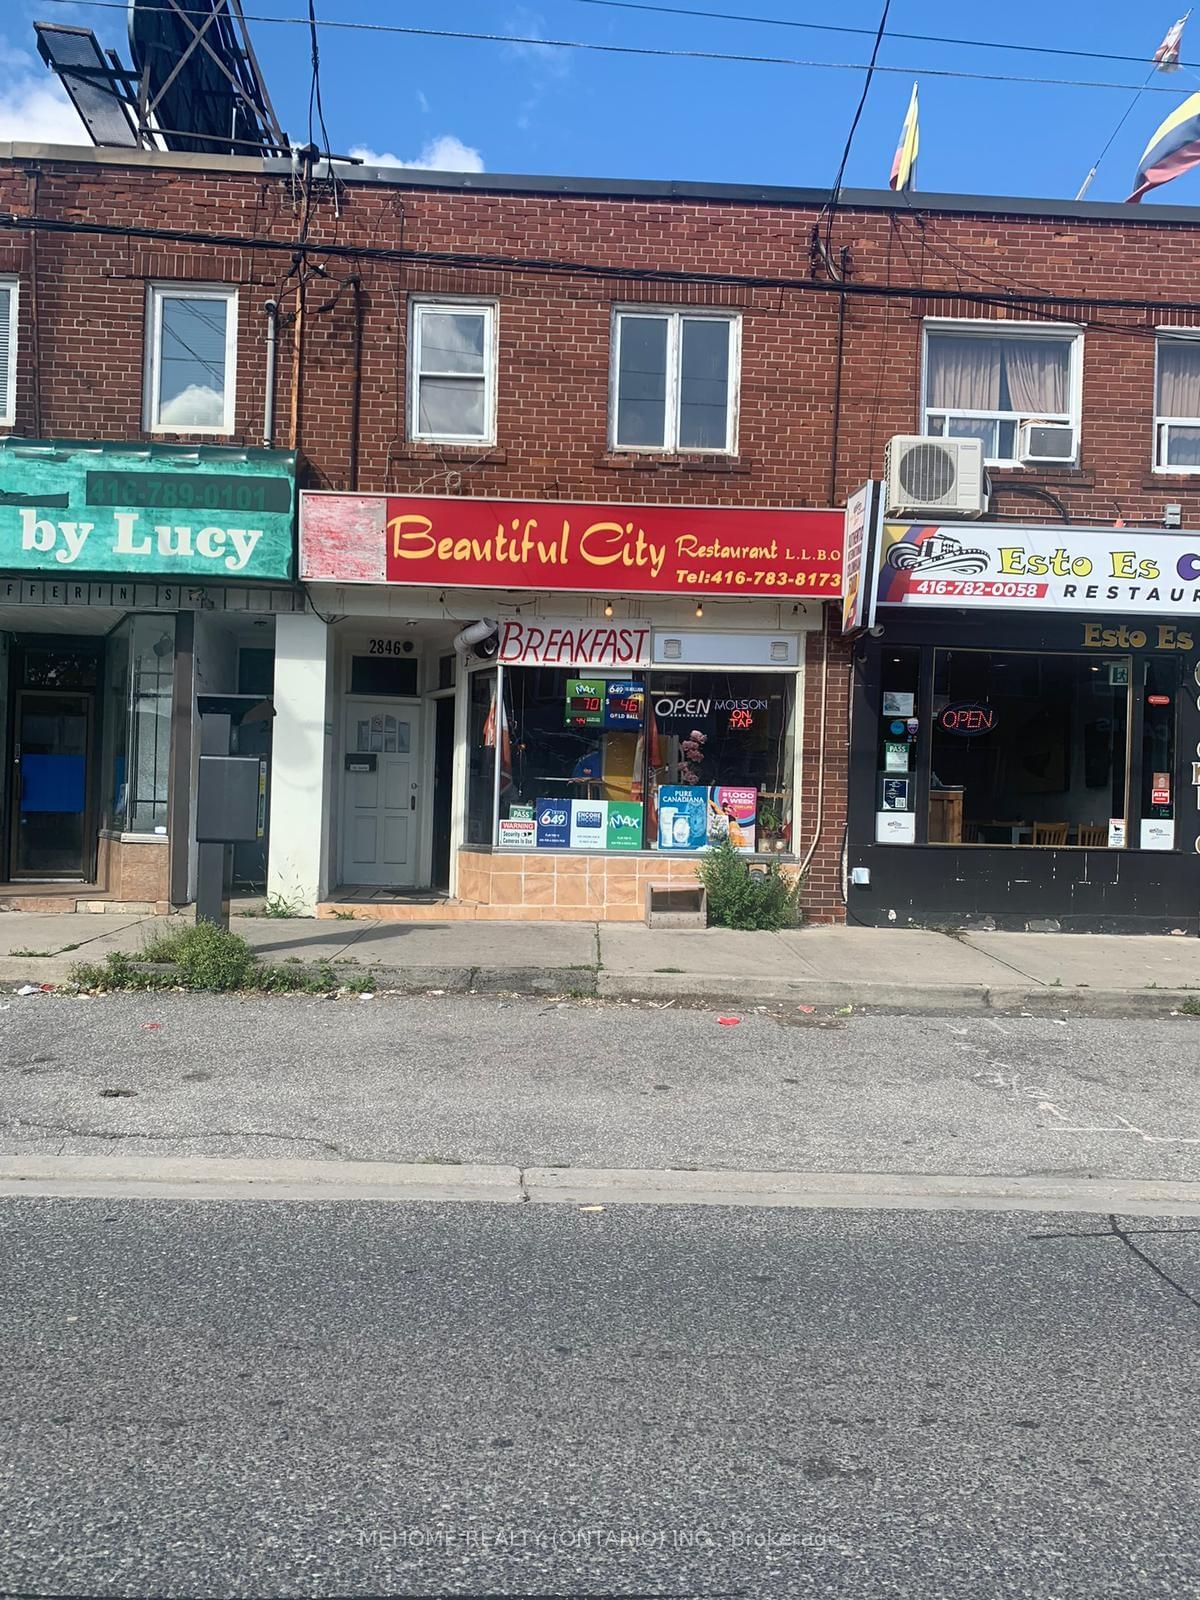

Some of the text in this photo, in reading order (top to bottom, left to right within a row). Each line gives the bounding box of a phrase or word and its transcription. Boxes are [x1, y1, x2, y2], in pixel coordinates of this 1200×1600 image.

[19, 509, 263, 570] by Lucy
[387, 514, 570, 565] Beautiful
[580, 521, 666, 578] City
[675, 534, 778, 560] Restaurant
[997, 546, 1093, 577] Esto
[1109, 550, 1160, 580] Es
[676, 569, 841, 587] Tel:416-783-8173
[917, 580, 1038, 598] 416-782-0058
[499, 621, 650, 663] BREAKFAST
[1081, 623, 1194, 650] Esto Es
[369, 639, 401, 656] 2846
[584, 698, 600, 710] 70
[620, 699, 638, 711] 46
[655, 698, 711, 717] OPEN
[715, 699, 768, 710] MOLSON
[729, 718, 753, 728] TAP
[732, 709, 750, 719] ON
[942, 710, 993, 728] OPEN
[513, 810, 530, 818] PASS
[609, 814, 640, 829] MAX
